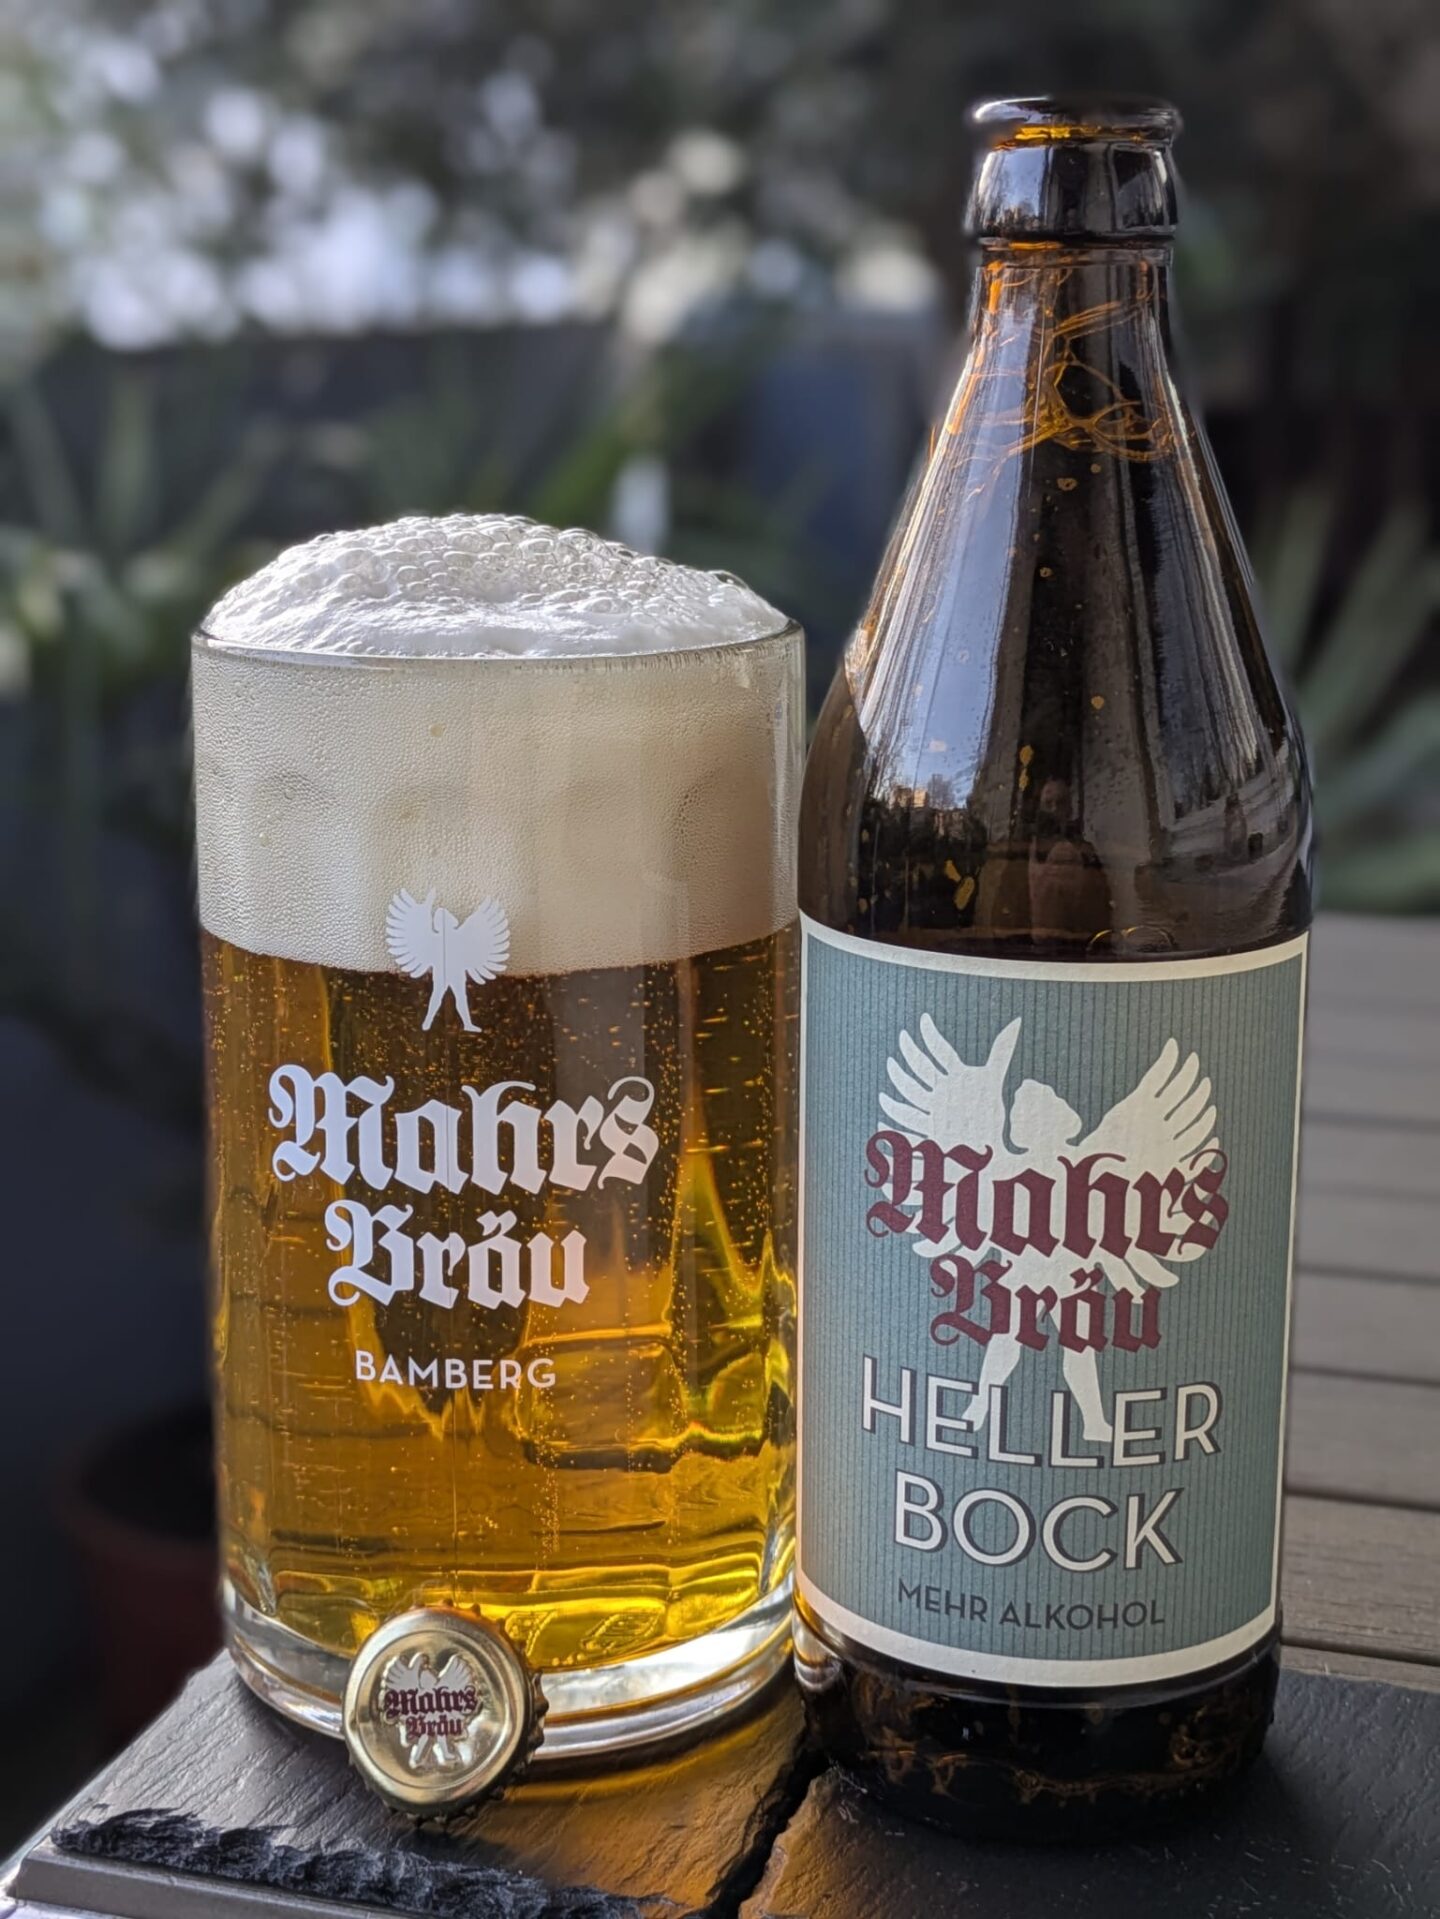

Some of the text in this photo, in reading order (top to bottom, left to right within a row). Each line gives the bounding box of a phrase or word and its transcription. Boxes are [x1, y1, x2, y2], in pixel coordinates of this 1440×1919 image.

[268, 1064, 660, 1195] Mahrs
[864, 1130, 1229, 1259] Mahrs
[324, 1199, 590, 1310] Bräu
[929, 1253, 1162, 1354] Bräu
[355, 1350, 557, 1390] BAMBERG
[862, 1354, 1223, 1468] HELLER
[893, 1468, 1185, 1574] BOCK
[898, 1580, 1166, 1631] MEHR ALKOHOL
[384, 1686, 477, 1718] Mahrs
[405, 1714, 463, 1739] Bräu
